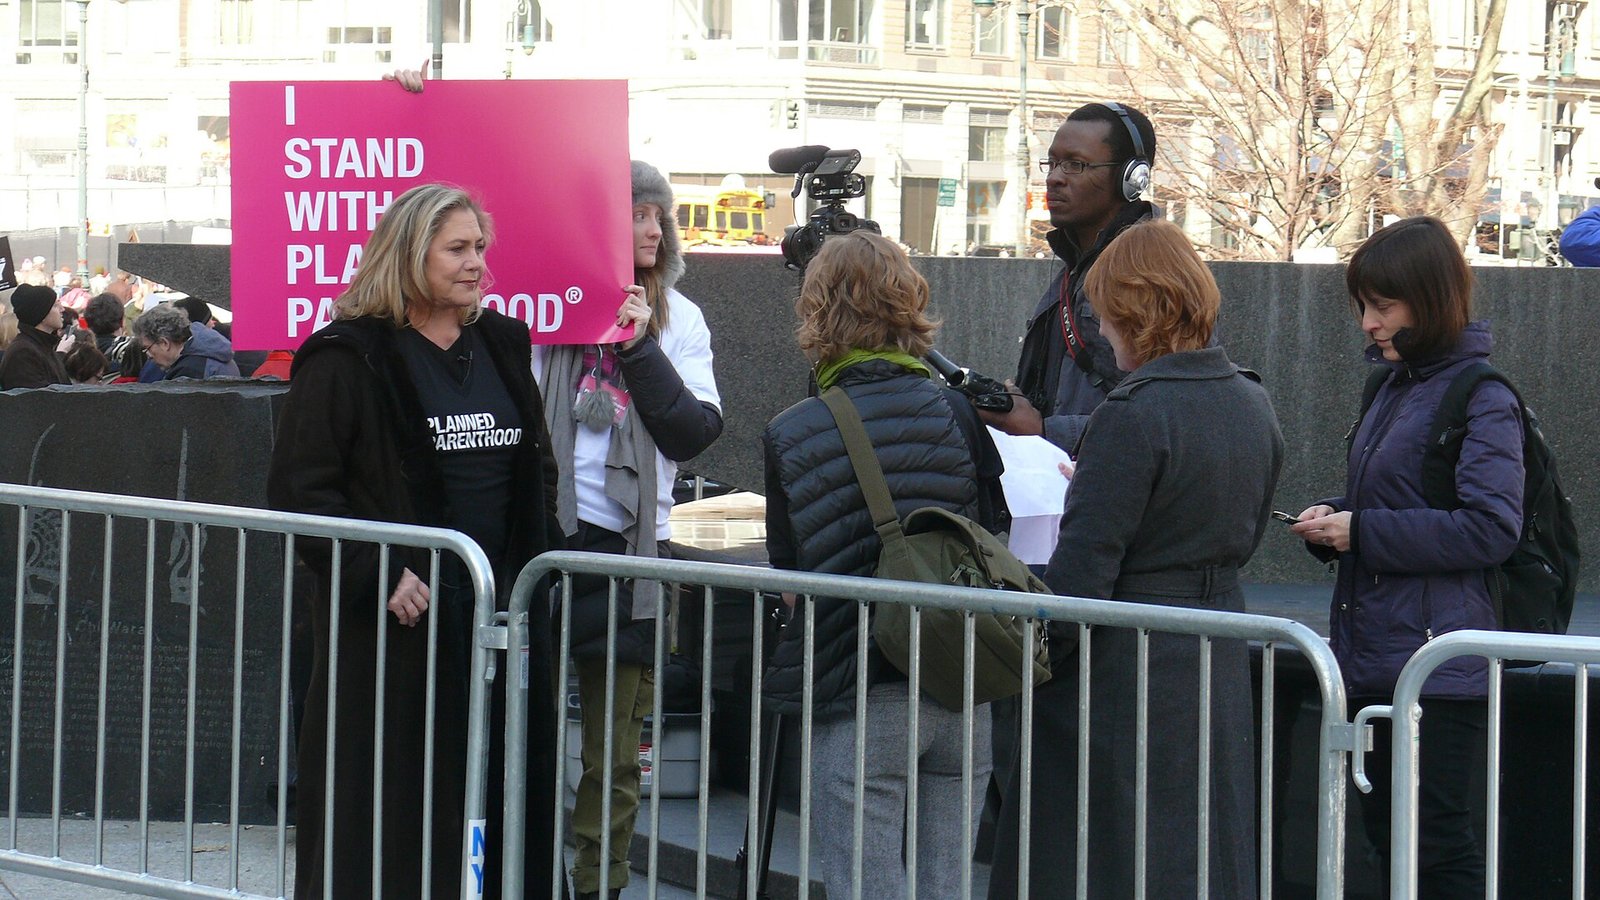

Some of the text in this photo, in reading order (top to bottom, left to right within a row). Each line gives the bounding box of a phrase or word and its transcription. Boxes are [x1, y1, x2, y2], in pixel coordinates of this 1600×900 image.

[285, 85, 296, 125] I
[284, 137, 425, 178] STAND
[285, 190, 393, 231] WITH
[432, 428, 522, 451] ARENTHOOD
